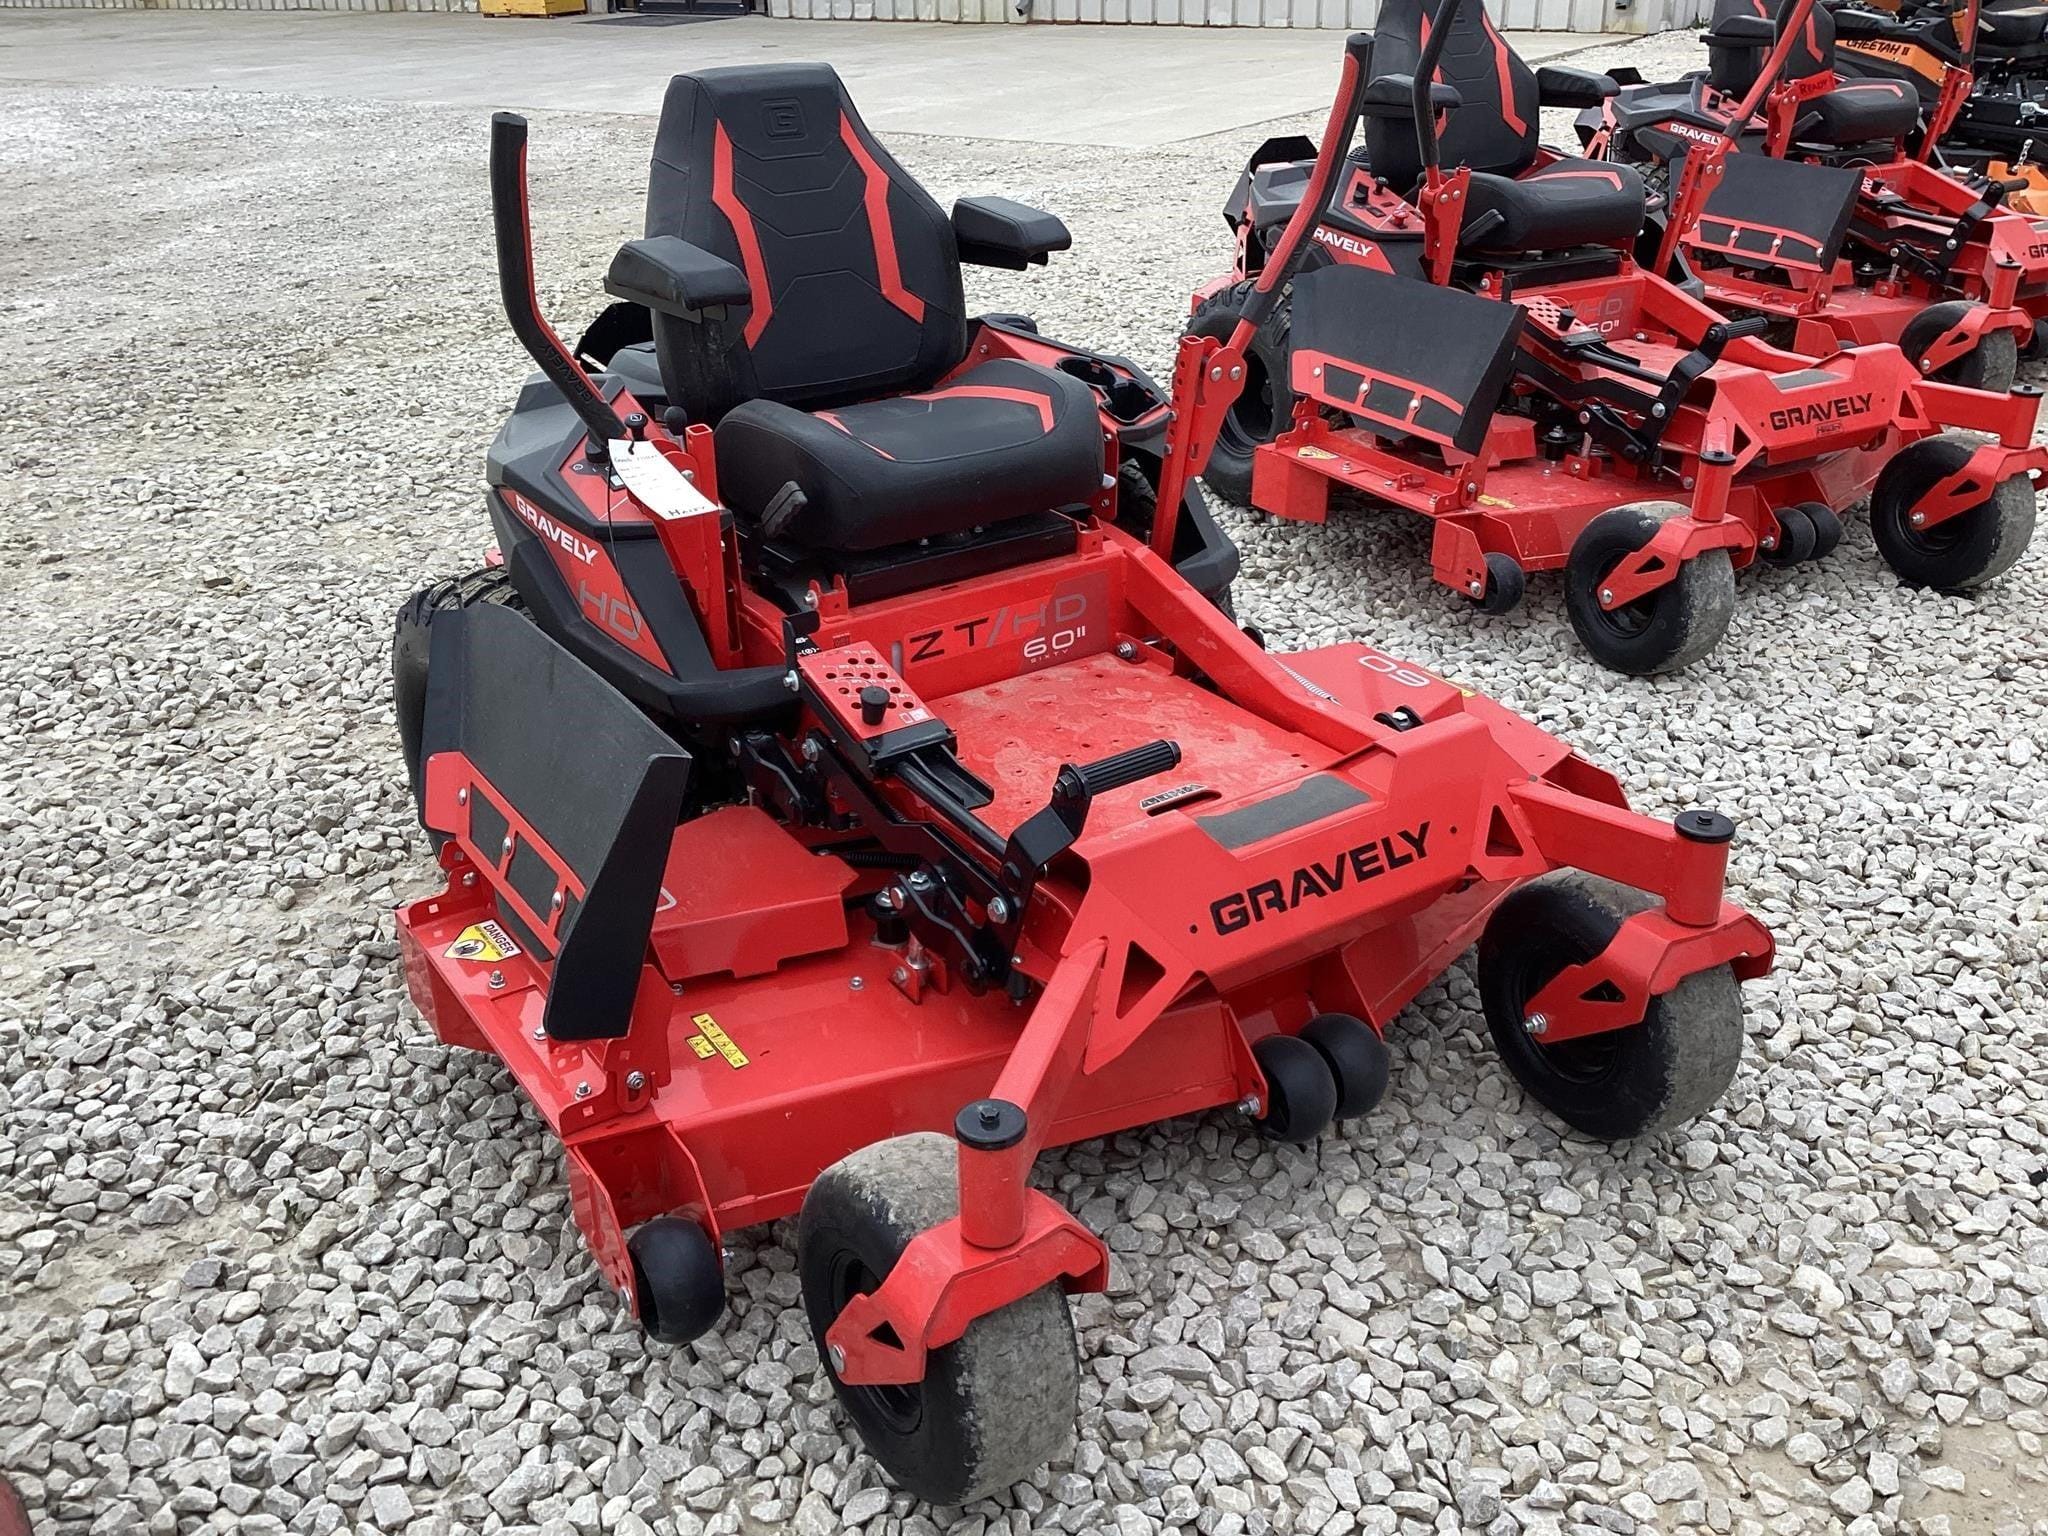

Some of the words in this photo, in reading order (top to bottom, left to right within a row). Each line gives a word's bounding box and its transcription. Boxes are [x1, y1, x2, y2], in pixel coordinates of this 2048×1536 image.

[1846, 40, 1900, 54] CHEETAH
[1313, 227, 1373, 257] RAVELY
[1769, 392, 1873, 431] GRAVELY
[515, 494, 598, 566] GRAVELY
[578, 579, 642, 641] HD
[1209, 820, 1431, 937] GRAVELY
[483, 923, 516, 954] DANGER
